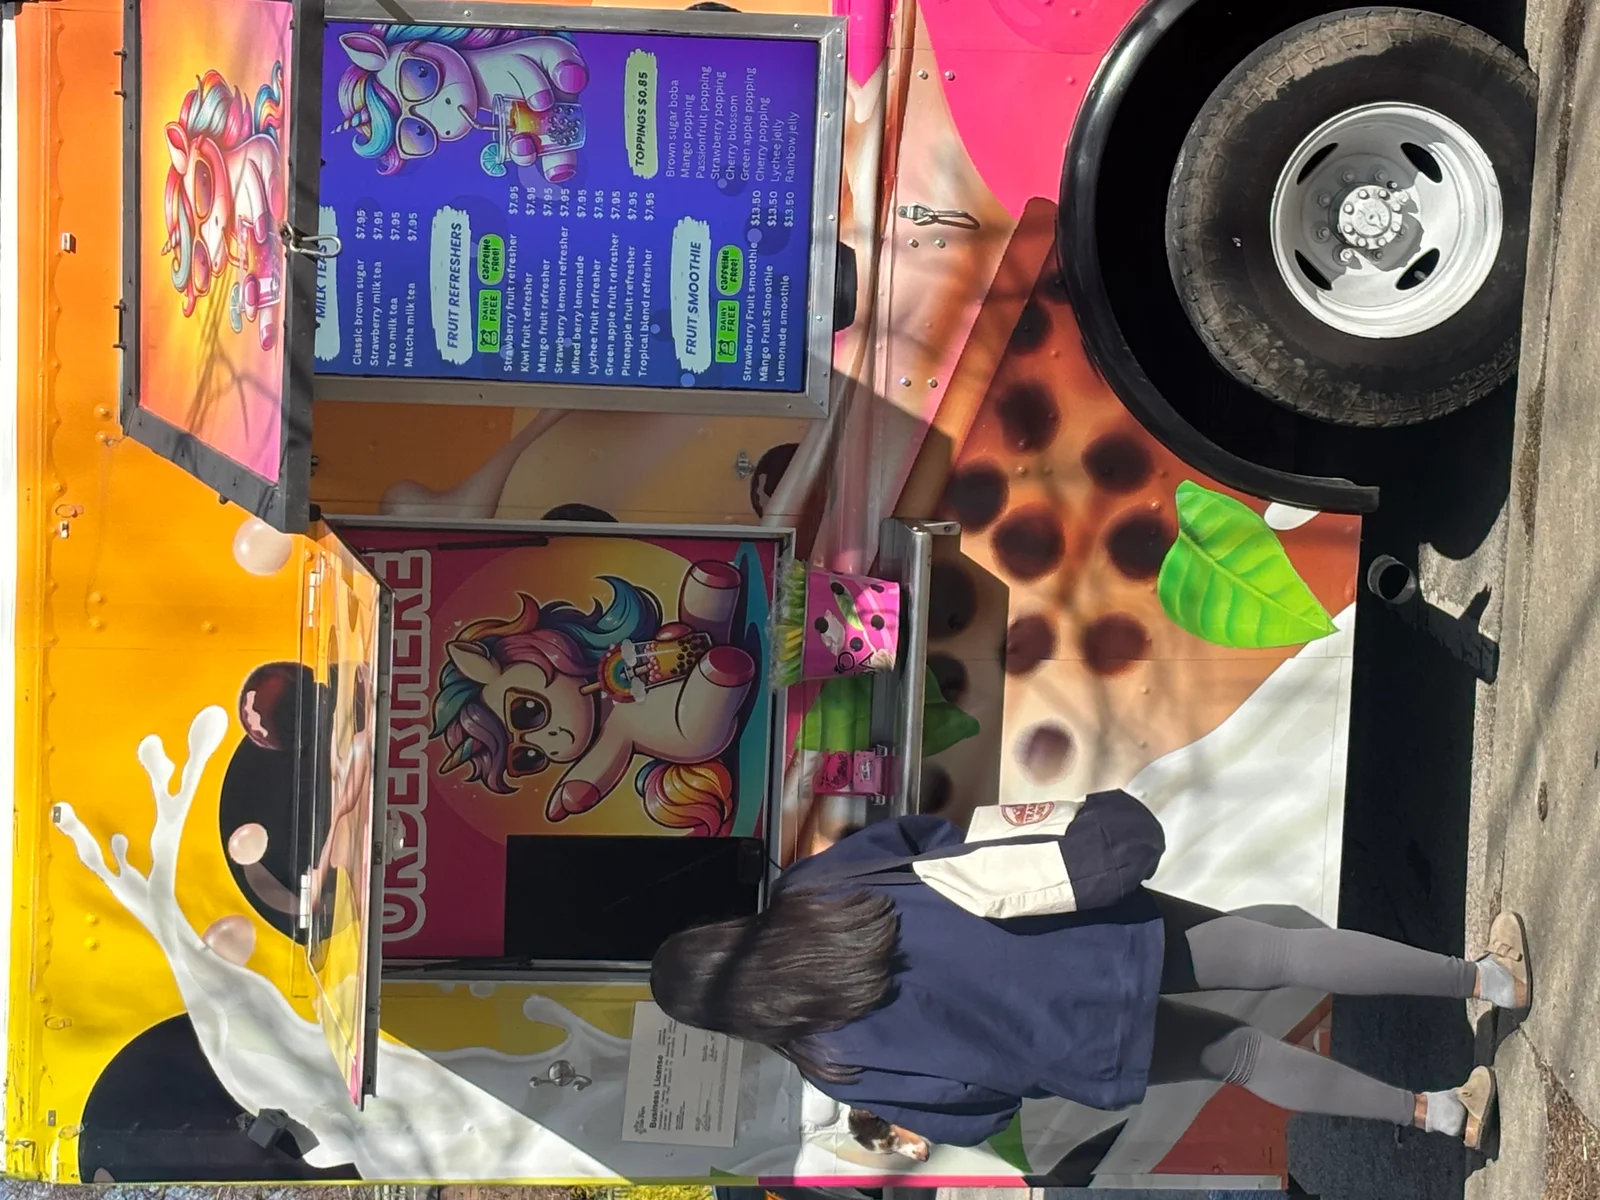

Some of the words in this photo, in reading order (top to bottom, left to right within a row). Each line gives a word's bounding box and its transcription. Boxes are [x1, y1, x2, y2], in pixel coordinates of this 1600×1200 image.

[637, 72, 648, 106] $0.85
[668, 80, 679, 107] boba
[700, 66, 712, 111] popping
[715, 72, 726, 116] popping
[745, 68, 757, 113] popping
[669, 110, 679, 140] sugar
[684, 94, 695, 139] popping
[727, 95, 738, 141] blossom
[743, 115, 754, 145] apple
[758, 98, 771, 142] popping
[772, 119, 785, 142] jelly
[787, 112, 800, 135] jelly
[635, 108, 646, 166] TOPPINGS
[696, 114, 708, 179] Passionfruit
[710, 119, 725, 179] Strawberry
[665, 143, 676, 177] Brown
[680, 142, 693, 178] Mango
[725, 143, 738, 180] Cherry
[740, 148, 750, 181] Green
[755, 145, 768, 181] Cherry
[770, 143, 782, 182] Lychee
[785, 137, 796, 182] Rainbow
[508, 186, 519, 214] $7.95
[525, 187, 536, 215] $7.95
[542, 187, 553, 216] $7.95
[559, 188, 570, 217] $7.95
[576, 189, 587, 218] $7.95
[593, 190, 604, 218] $7.95
[610, 191, 621, 219] $7.95
[627, 192, 638, 220] $7.95
[644, 192, 654, 221] $7.95
[750, 190, 761, 226] $13.50
[767, 191, 778, 226] $13.50
[783, 192, 794, 227] $13.50
[355, 210, 366, 239] $7.95
[372, 211, 383, 240] $7.95
[390, 212, 400, 240] $7.95
[407, 213, 418, 241] $7.95
[448, 222, 462, 307] REFRESHERS
[506, 234, 517, 283] refresher
[558, 226, 568, 276] refresher
[609, 233, 619, 283] refresher
[748, 241, 758, 292] smoothie
[357, 259, 367, 289] sugar
[373, 262, 382, 279] tea
[540, 259, 550, 309] refresher
[573, 255, 584, 308] lemonade
[591, 259, 601, 309] refresher
[625, 246, 635, 295] refresher
[642, 249, 652, 298] refresher
[687, 242, 701, 314] SMOOTHIE
[316, 284, 326, 319] MILK
[372, 281, 381, 304] milk
[389, 298, 398, 315] tea
[407, 283, 415, 300] tea
[505, 287, 515, 310] fruit
[522, 272, 533, 322] refresher
[556, 279, 566, 312] lemon
[607, 285, 617, 309] fruit
[745, 295, 755, 320] Fruit
[762, 265, 773, 316] Smoothie
[780, 275, 790, 325] smoothie
[354, 292, 363, 325] brown
[405, 303, 415, 325] milk
[489, 295, 498, 321] FREE
[538, 311, 548, 335] fruit
[589, 311, 599, 334] fruit
[623, 297, 633, 321] fruit
[640, 301, 650, 332] blend
[727, 305, 736, 332] FREE
[370, 306, 382, 366] Strawberry
[388, 318, 397, 340] milk
[447, 309, 459, 349] FRUIT
[503, 312, 516, 371] Strawberry
[521, 324, 531, 348] fruit
[572, 311, 584, 340] berry
[607, 311, 617, 341] apple
[686, 316, 697, 355] FRUIT
[761, 319, 770, 344] Fruit
[352, 328, 362, 365] Classic
[387, 343, 396, 367] Taro
[404, 329, 414, 367] Matcha
[520, 350, 530, 372] Kiwi
[537, 337, 549, 372] Mango
[554, 315, 567, 374] Strawberry
[571, 342, 581, 374] Mixed
[588, 337, 599, 375] Lychee
[605, 344, 614, 376] Green
[621, 324, 634, 376] Pineapple
[638, 334, 650, 377] Tropical
[743, 322, 756, 381] Strawberry
[776, 328, 787, 382] Lemonade
[759, 347, 771, 381] Mango
[653, 1055, 663, 1087] License
[649, 1090, 660, 1128] Business
